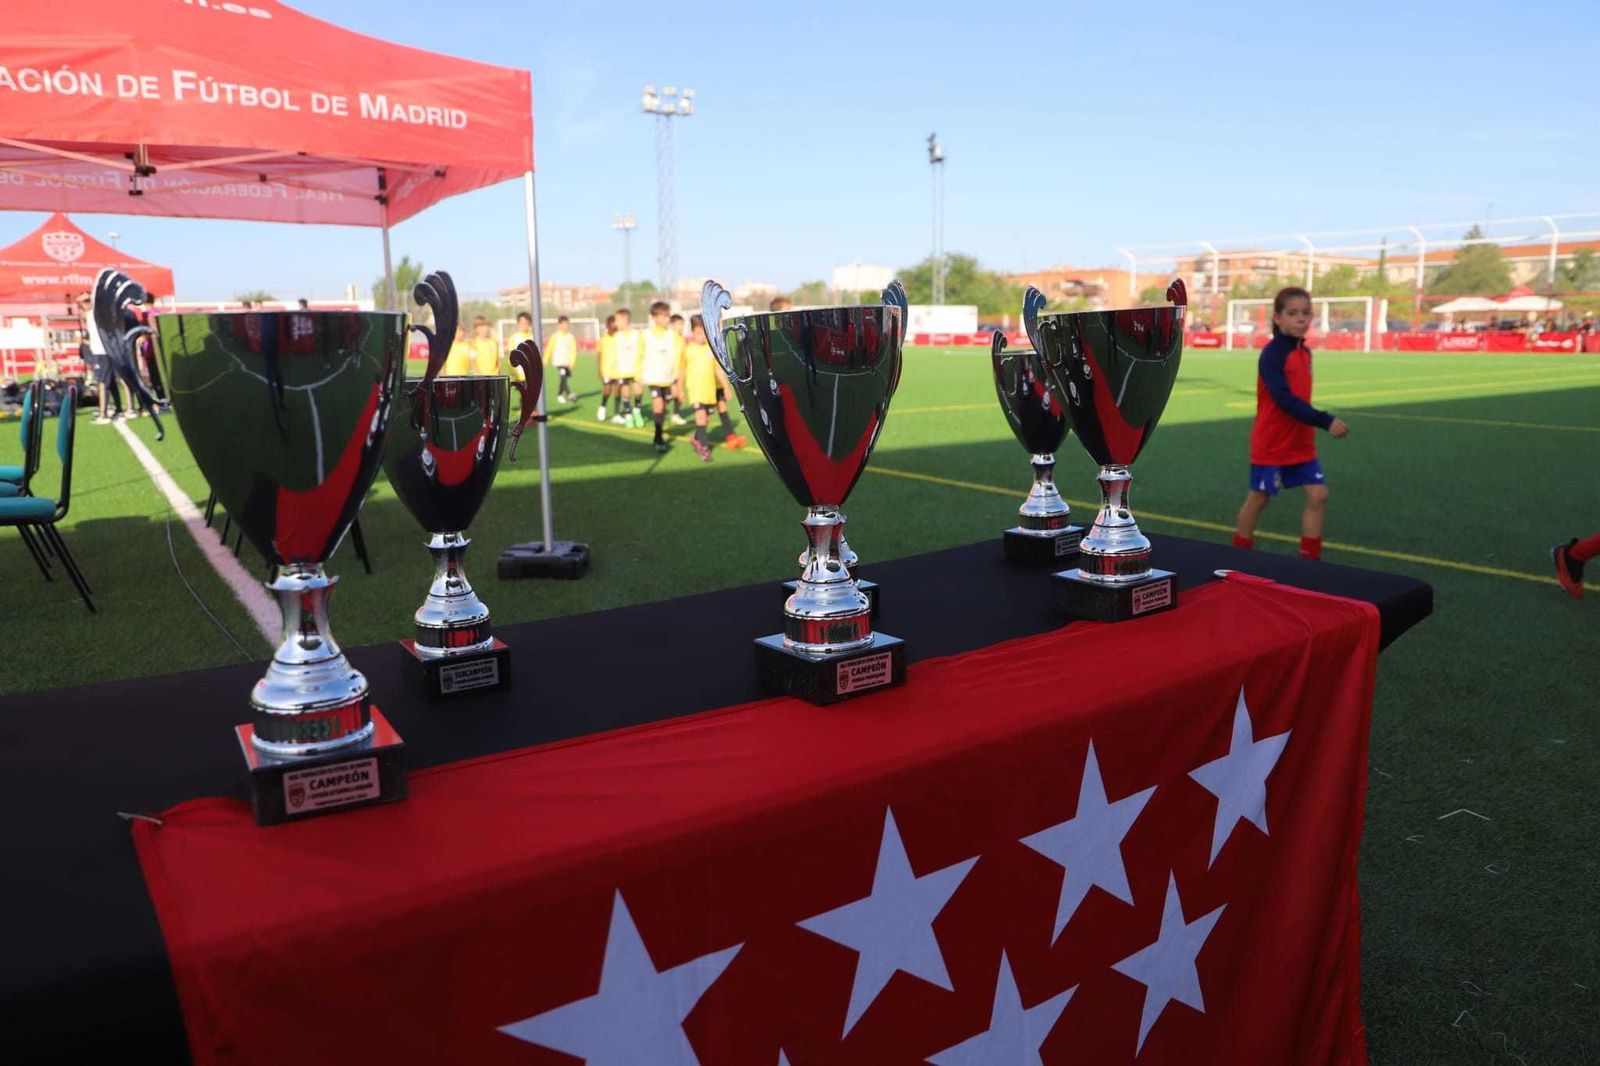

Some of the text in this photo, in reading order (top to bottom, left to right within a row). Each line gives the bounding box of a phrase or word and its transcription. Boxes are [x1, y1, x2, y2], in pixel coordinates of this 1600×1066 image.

[0, 64, 468, 128] ACIÓN DE FÚTBOL DE MADRID
[22, 273, 94, 286] www.rffm
[851, 661, 886, 676] CAMPEÓN
[309, 770, 369, 790] CAMPEÓN
